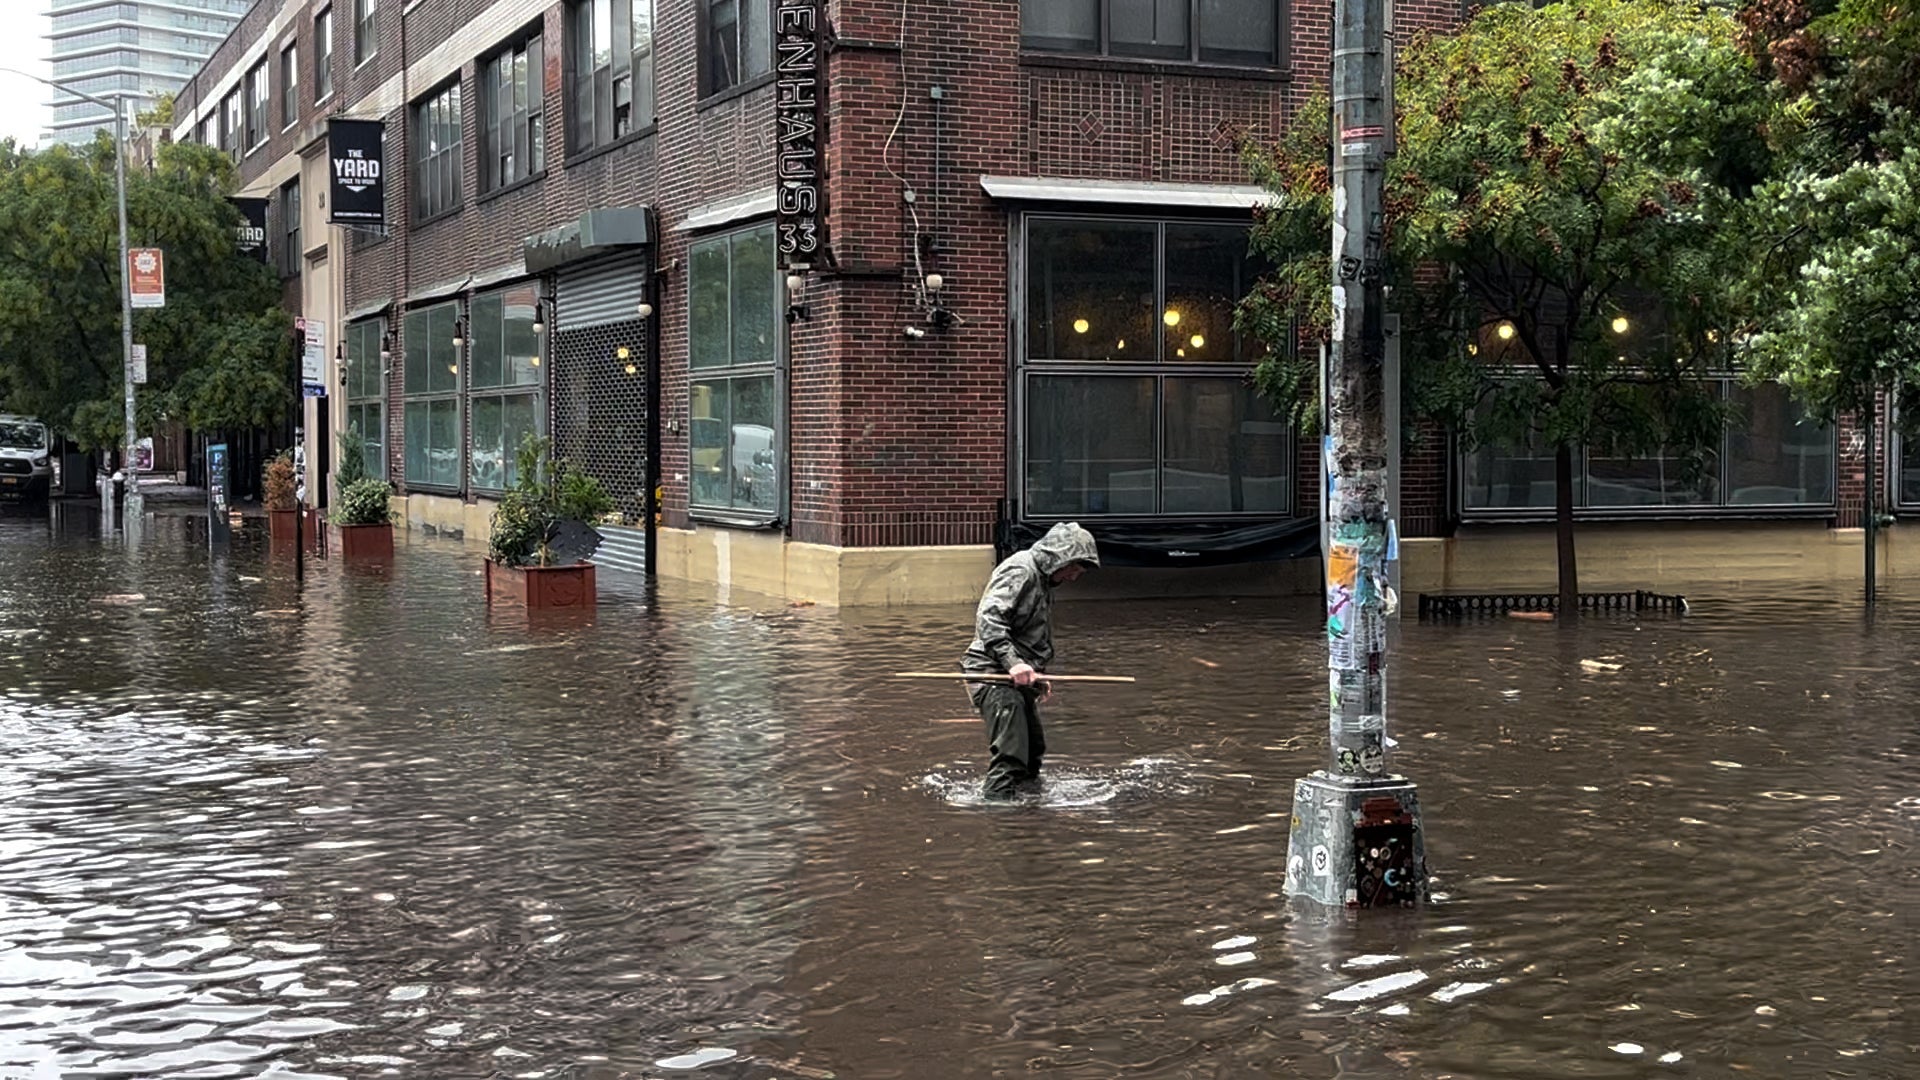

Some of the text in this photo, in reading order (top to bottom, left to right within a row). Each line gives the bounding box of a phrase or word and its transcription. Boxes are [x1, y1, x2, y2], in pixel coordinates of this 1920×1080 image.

[347, 149, 363, 158] THE
[333, 158, 380, 177] YARD
[778, 223, 817, 253] 33
